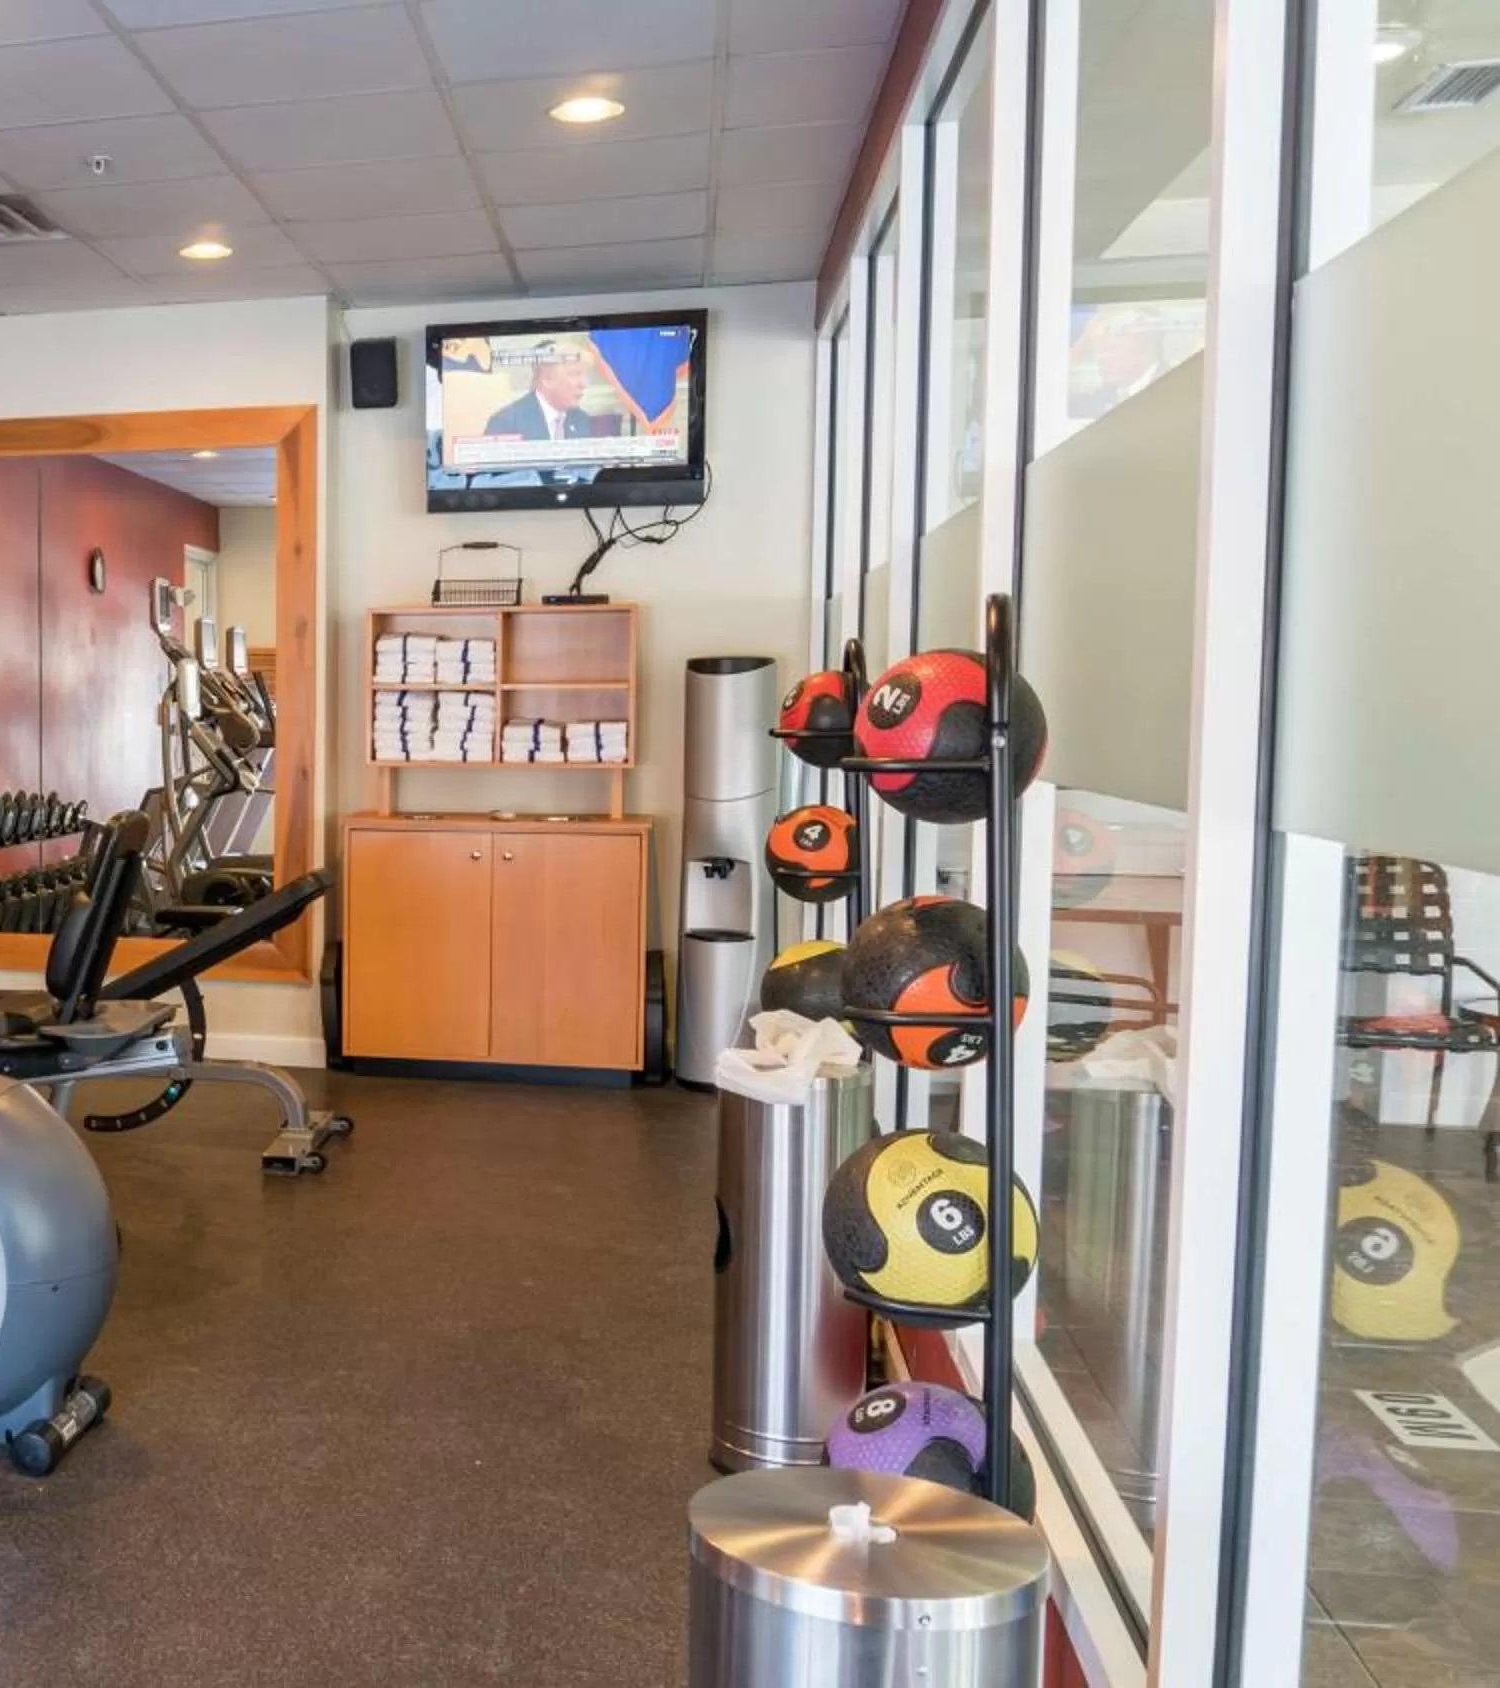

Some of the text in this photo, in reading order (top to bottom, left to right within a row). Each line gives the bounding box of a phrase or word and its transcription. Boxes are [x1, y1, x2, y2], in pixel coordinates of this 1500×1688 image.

[803, 824, 823, 840] 4
[930, 1199, 963, 1231] 6
[866, 1399, 897, 1417] 8
